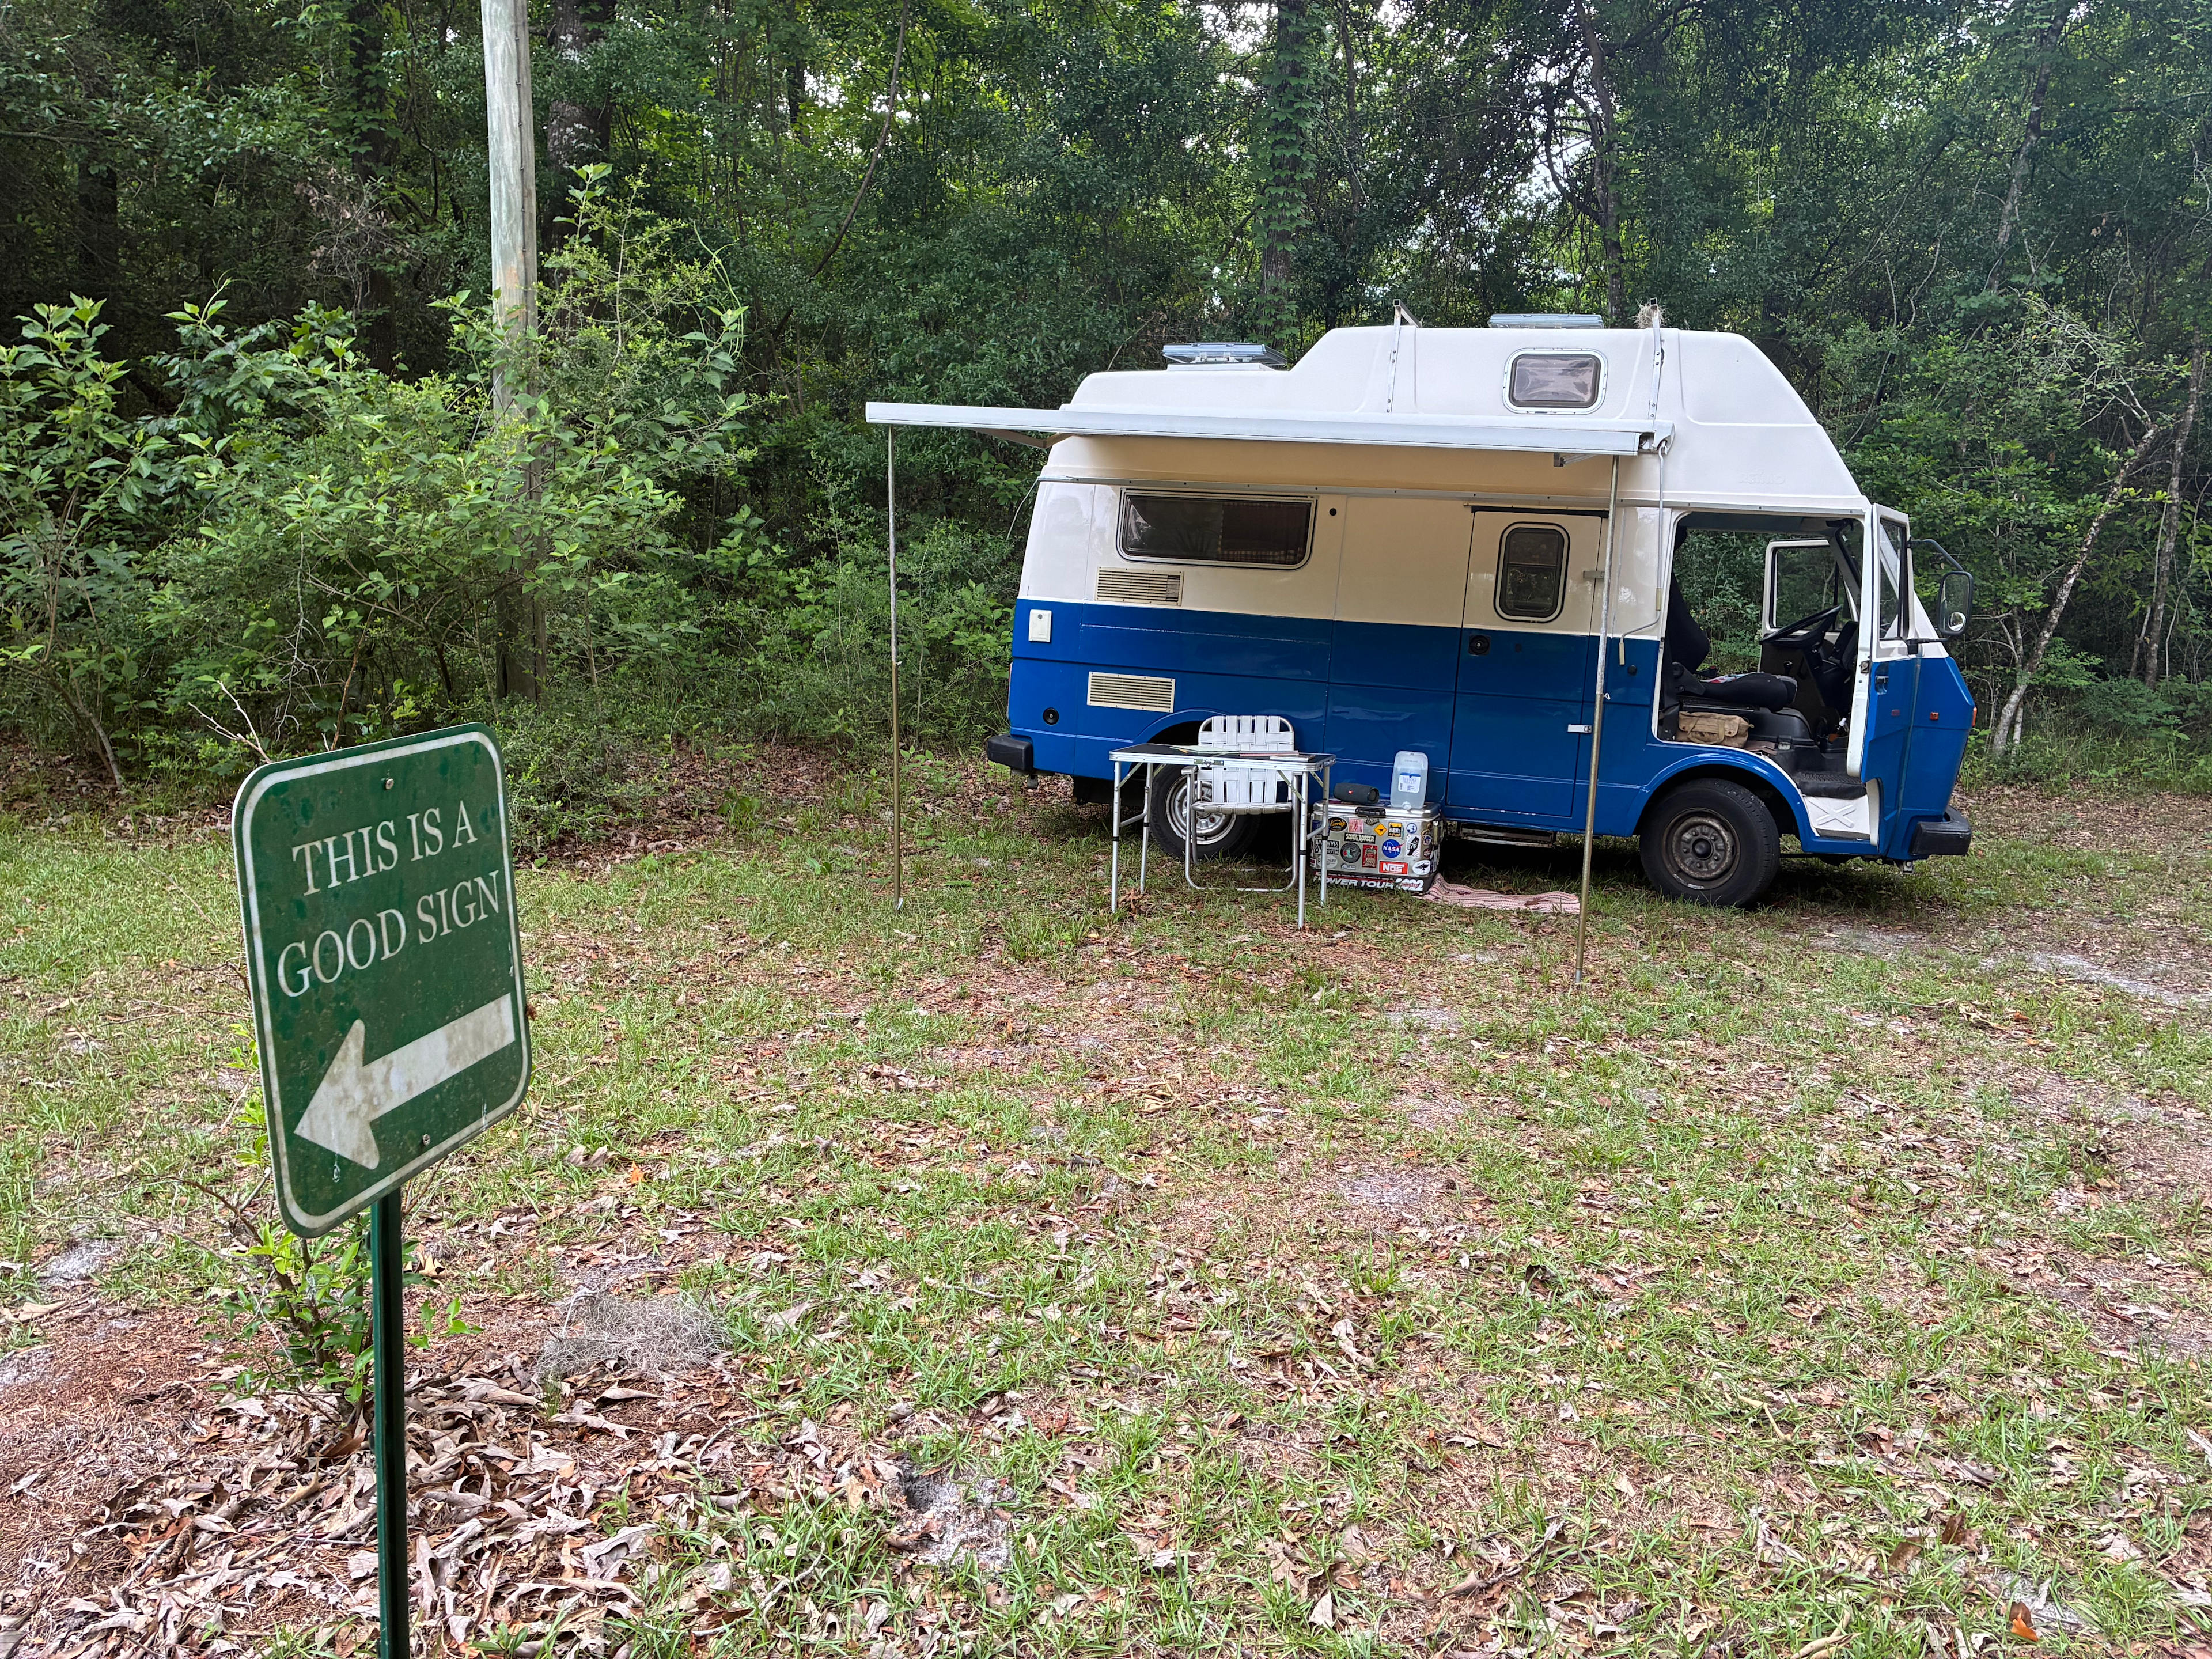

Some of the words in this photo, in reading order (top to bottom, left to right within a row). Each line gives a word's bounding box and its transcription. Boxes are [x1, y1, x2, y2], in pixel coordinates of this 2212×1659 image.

[292, 820, 399, 896] THIS
[407, 808, 444, 862] IS
[452, 800, 478, 849] A
[1382, 845, 1400, 853] NASA
[1382, 863, 1404, 873] NOS
[1361, 880, 1394, 889] TOUR
[1395, 878, 1424, 892] 2022
[277, 908, 407, 997] GOOD
[416, 870, 499, 945] SIGN
